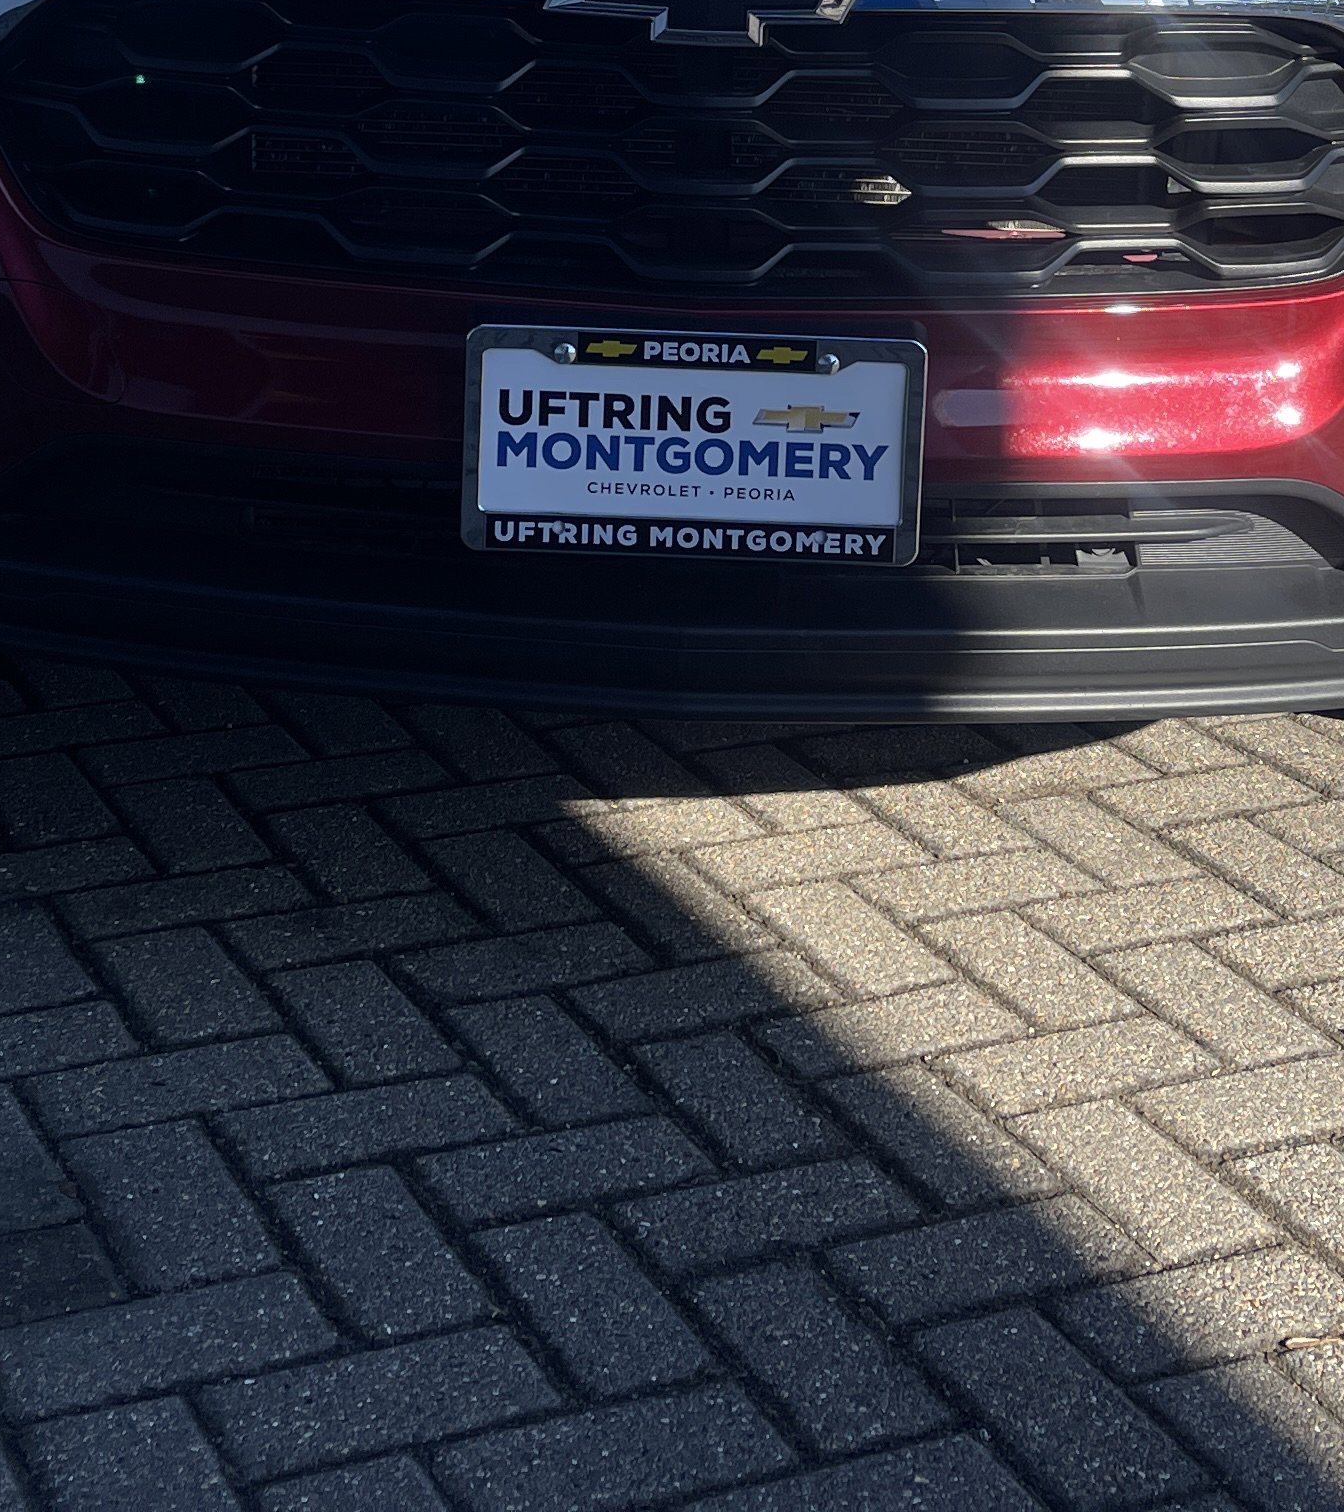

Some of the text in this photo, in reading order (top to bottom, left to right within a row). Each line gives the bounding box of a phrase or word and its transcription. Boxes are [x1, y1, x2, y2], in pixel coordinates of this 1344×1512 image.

[643, 340, 751, 364] PEORIA
[498, 388, 732, 434] UFTRING
[496, 430, 890, 481] MONTGOMERY
[586, 481, 795, 502] CHEVROLET PEORIA
[494, 520, 887, 556] UFTRING MONTGOMERY
